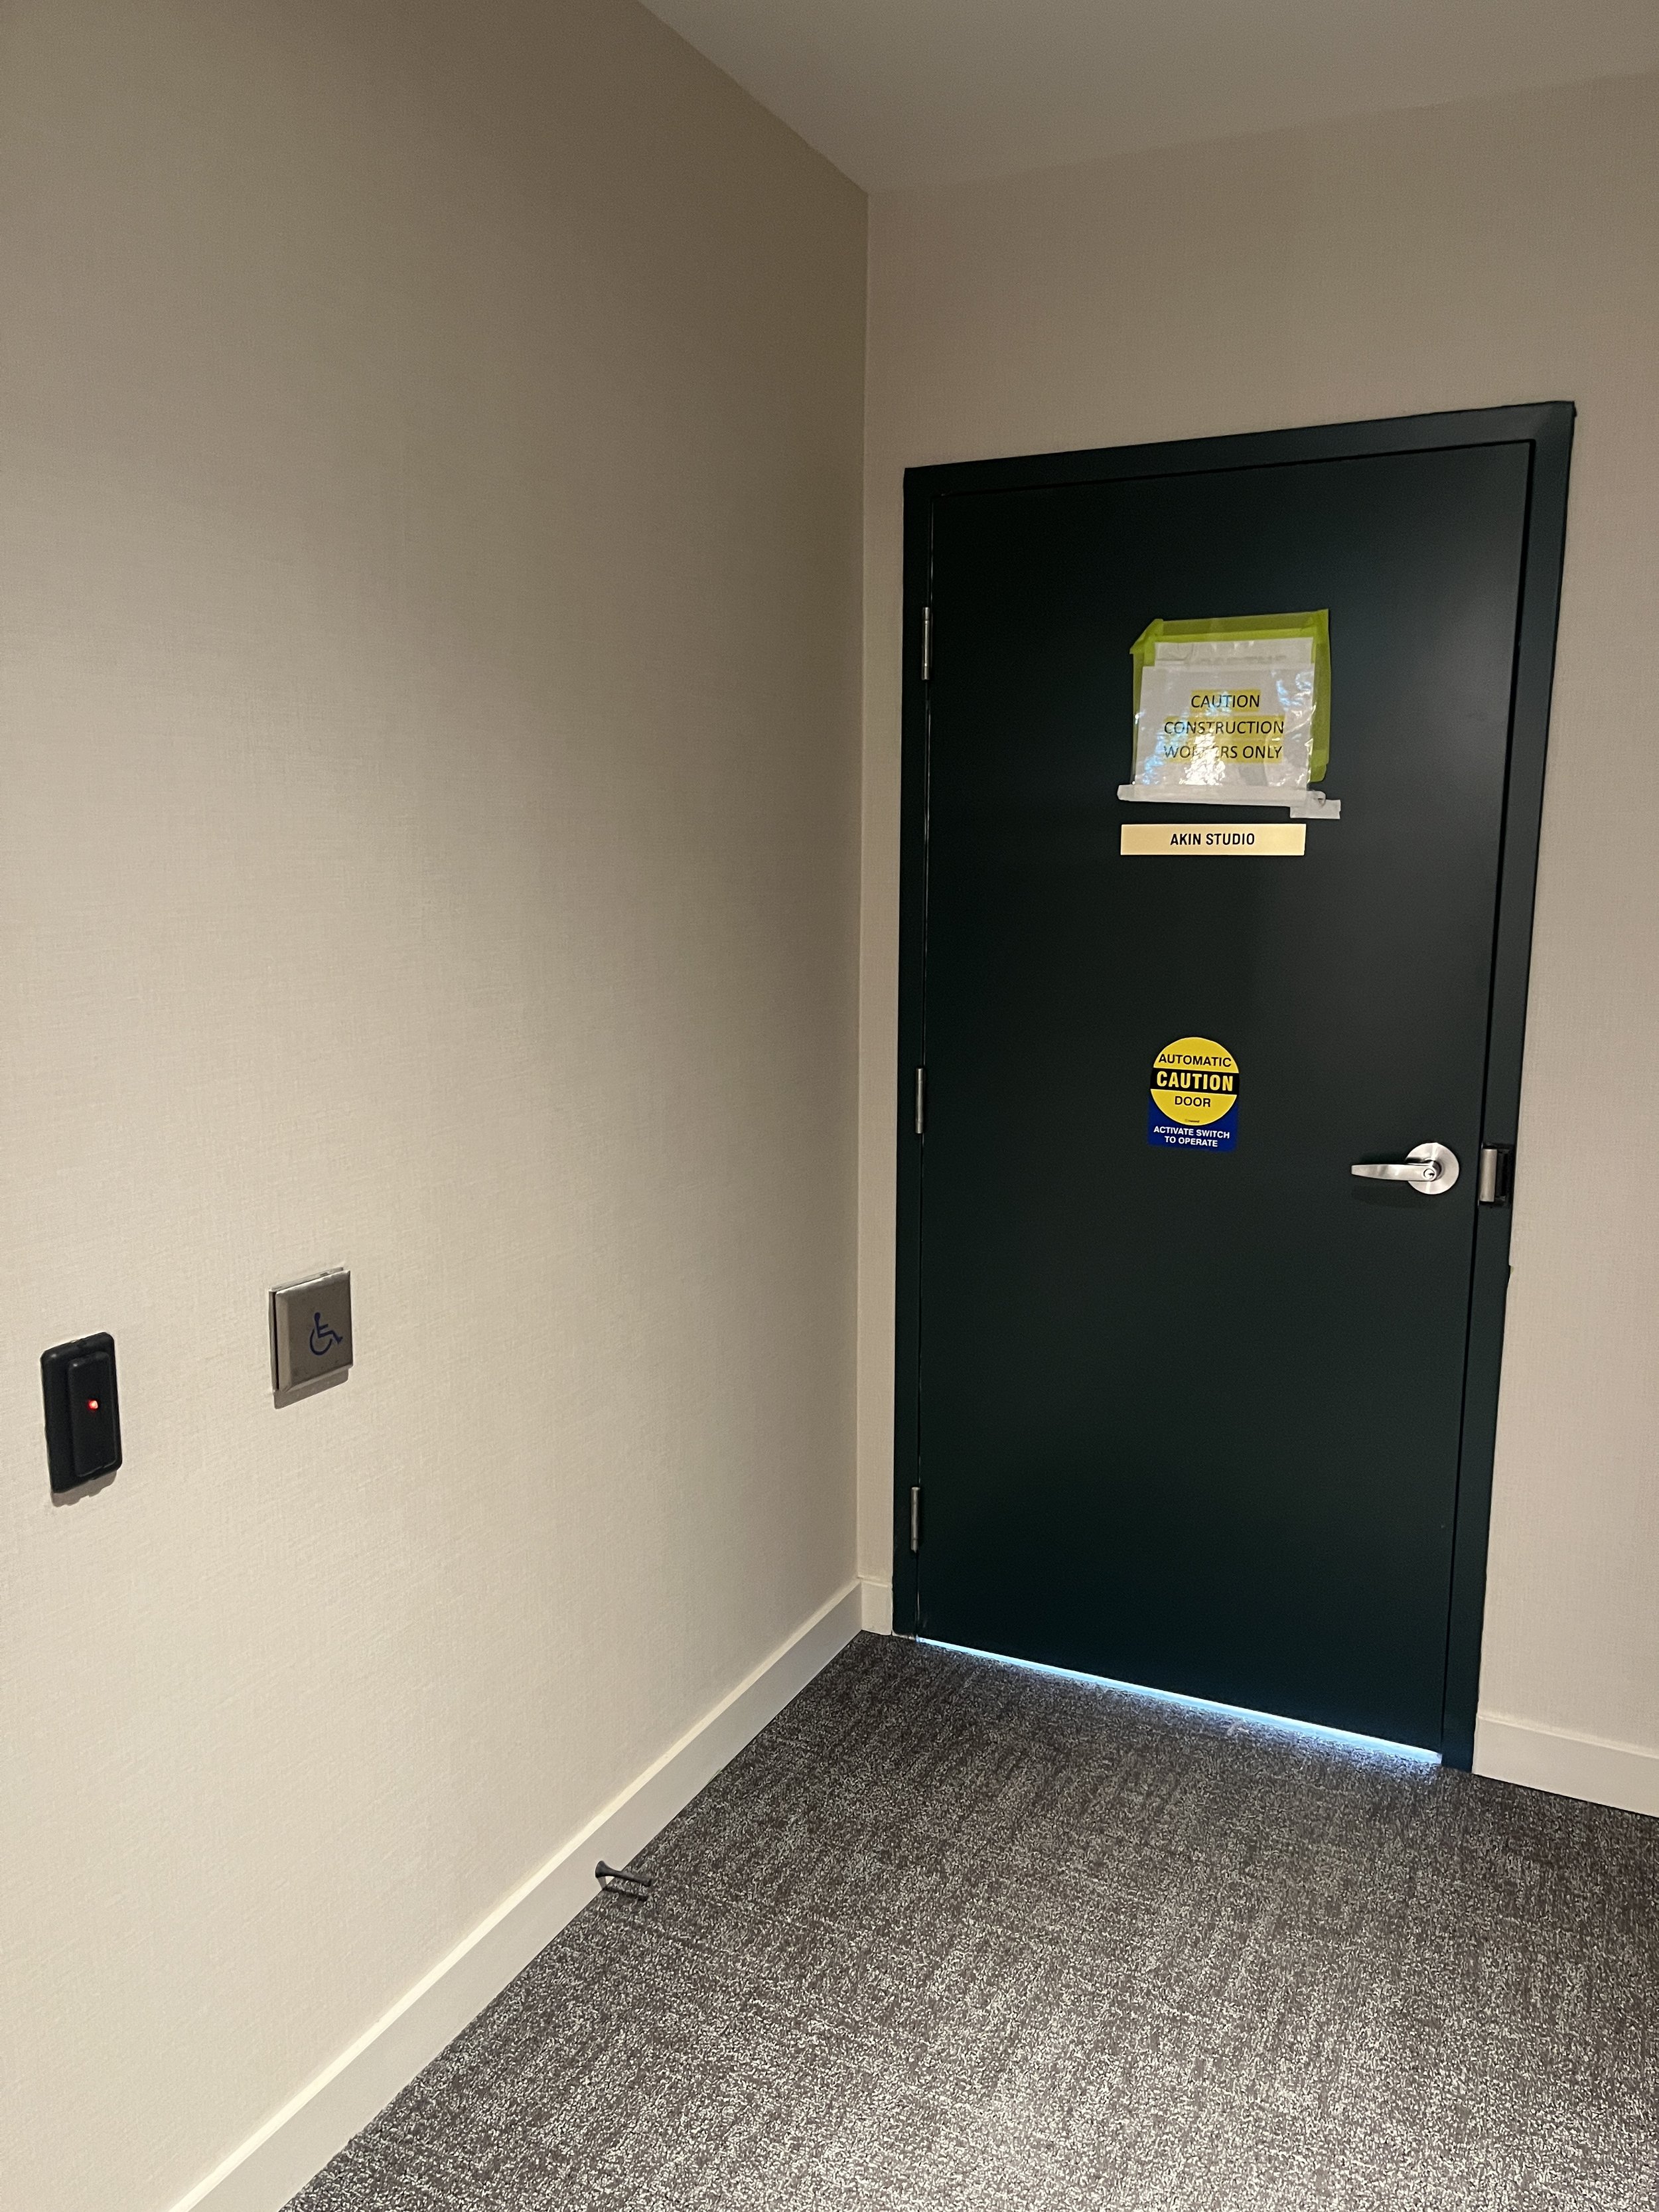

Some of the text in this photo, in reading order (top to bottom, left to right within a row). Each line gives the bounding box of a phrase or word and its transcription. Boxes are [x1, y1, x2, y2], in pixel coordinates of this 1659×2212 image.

[1191, 694, 1260, 708] CAUTION
[1164, 721, 1284, 735] CONSTRUCTION
[1164, 745, 1283, 759] WORS ONLY
[1170, 833, 1255, 846] AKIN STUDIO
[1159, 1053, 1232, 1067] AUTOMATIC
[1157, 1070, 1233, 1092] CAUTION
[1175, 1096, 1211, 1108] DOOR
[1153, 1126, 1230, 1139] ACTIVATE SWITCH
[1178, 1137, 1218, 1147] OPERATE
